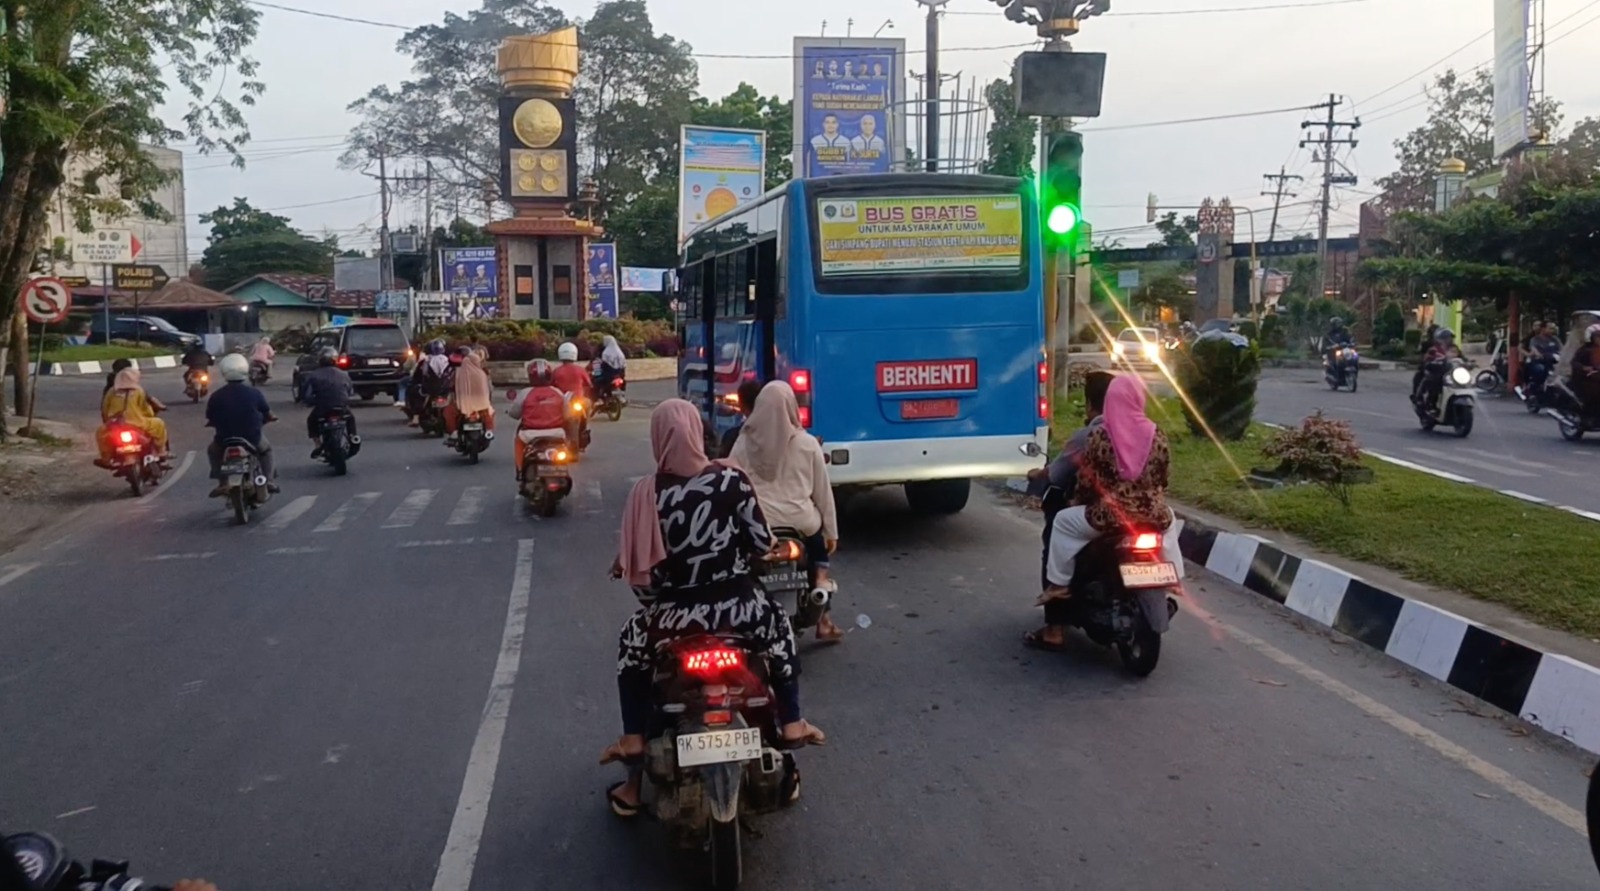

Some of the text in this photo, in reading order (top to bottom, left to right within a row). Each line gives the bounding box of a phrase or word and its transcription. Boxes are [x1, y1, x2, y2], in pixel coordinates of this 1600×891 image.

[865, 205, 977, 223] BUS GRATIS
[859, 222, 986, 234] UNTUK MASYARAKAT UMUM
[117, 268, 153, 276] POLRES
[118, 279, 153, 287] LANGKAT
[883, 364, 970, 386] BERHENTI
[698, 732, 731, 750] 5752
[734, 730, 759, 745] PBF
[726, 749, 760, 759] 12 27
